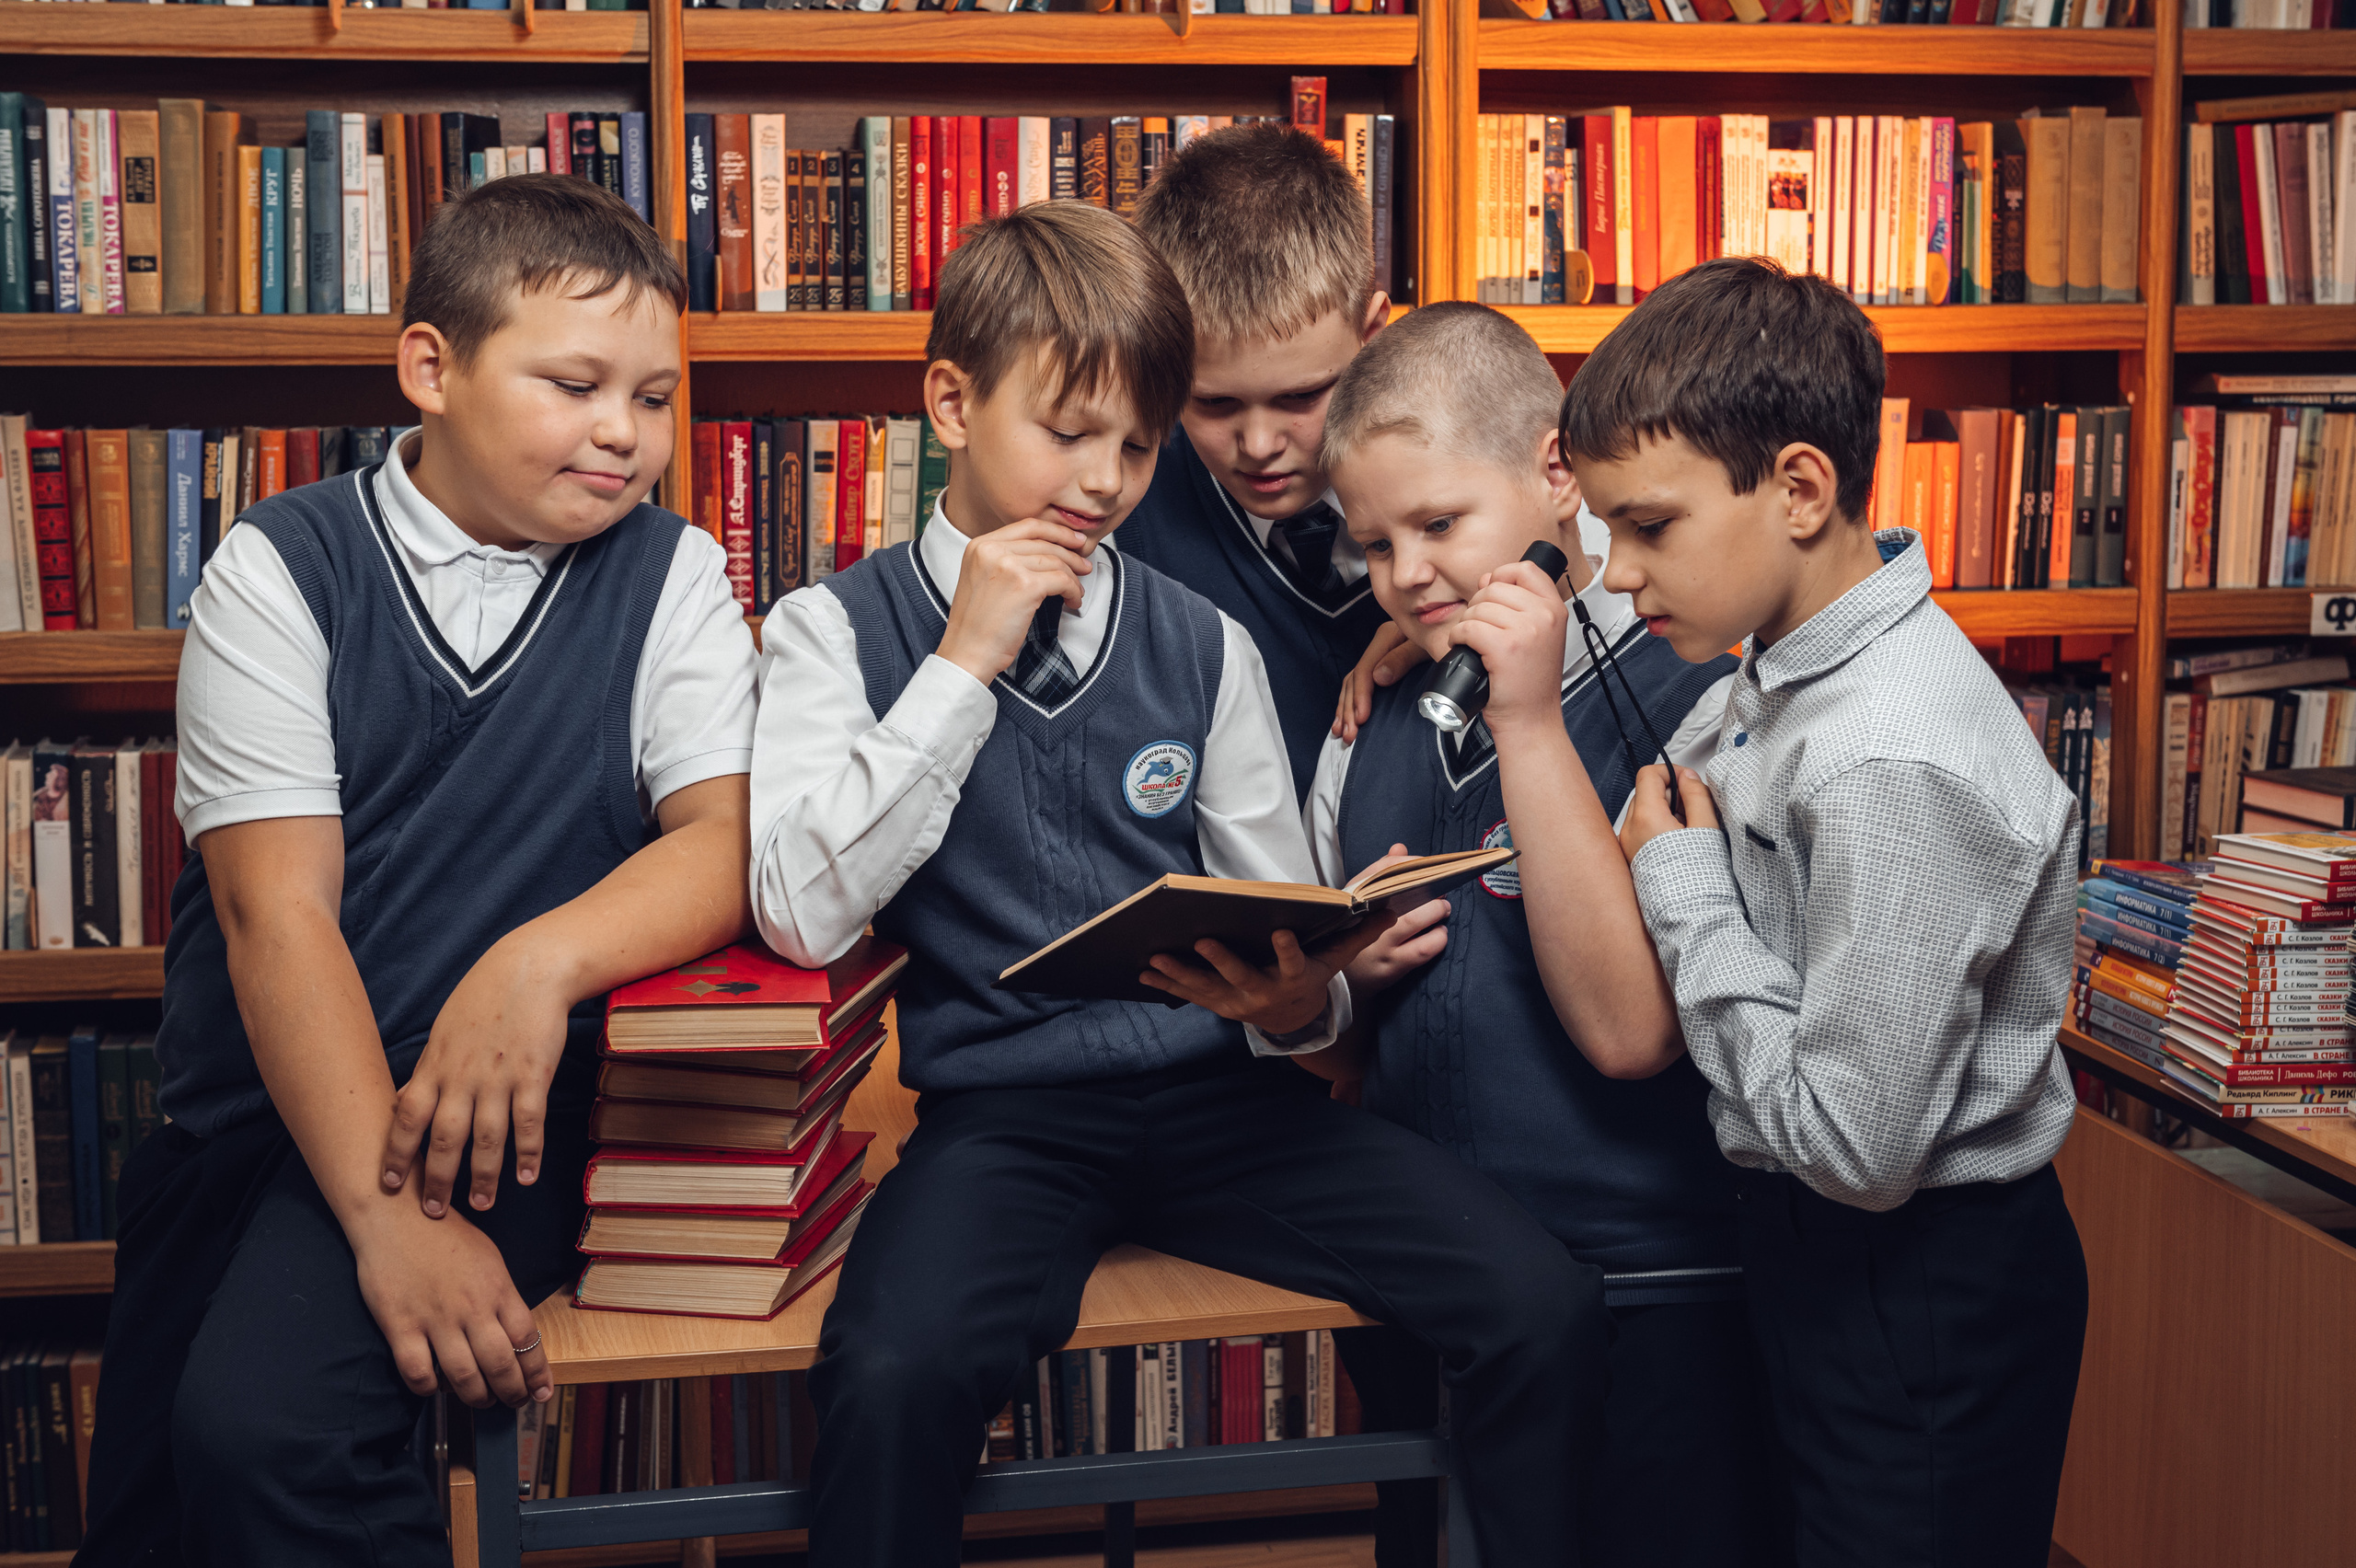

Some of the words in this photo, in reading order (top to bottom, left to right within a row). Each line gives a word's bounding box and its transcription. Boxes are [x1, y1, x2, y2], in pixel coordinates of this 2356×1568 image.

[628, 127, 641, 198] КУКОЦКОГО
[808, 161, 815, 170] 2
[828, 161, 837, 171] 3
[851, 163, 860, 173] 4
[895, 143, 907, 199] СКАЗКИ
[1503, 148, 1511, 202] ПАСТЕРНАК
[1594, 143, 1607, 202] Пастернак
[266, 168, 279, 206] КРУГ
[292, 167, 304, 208] НОЧЬ
[1595, 203, 1608, 234] Борис
[57, 201, 76, 308] ТОКАРЕВА
[103, 201, 122, 309] ТОКАРЕВА
[895, 205, 907, 297] БАБУШКИНЫ
[177, 472, 191, 527] Даниил
[1942, 482, 1952, 530] СМЕЛЯКОВ
[175, 531, 191, 578] Хармс
[2115, 892, 2157, 916] ИНФОРМАТИКА
[2117, 909, 2157, 933] ИНФОРМАТИКА
[2111, 936, 2151, 959] ИНФОРМАТИКА
[2284, 1070, 2315, 1079] Даниэль
[2316, 1069, 2338, 1080] Дефо
[1322, 1343, 1330, 1393] ГАМЗАТОВ
[1167, 1387, 1179, 1433] Андрей
